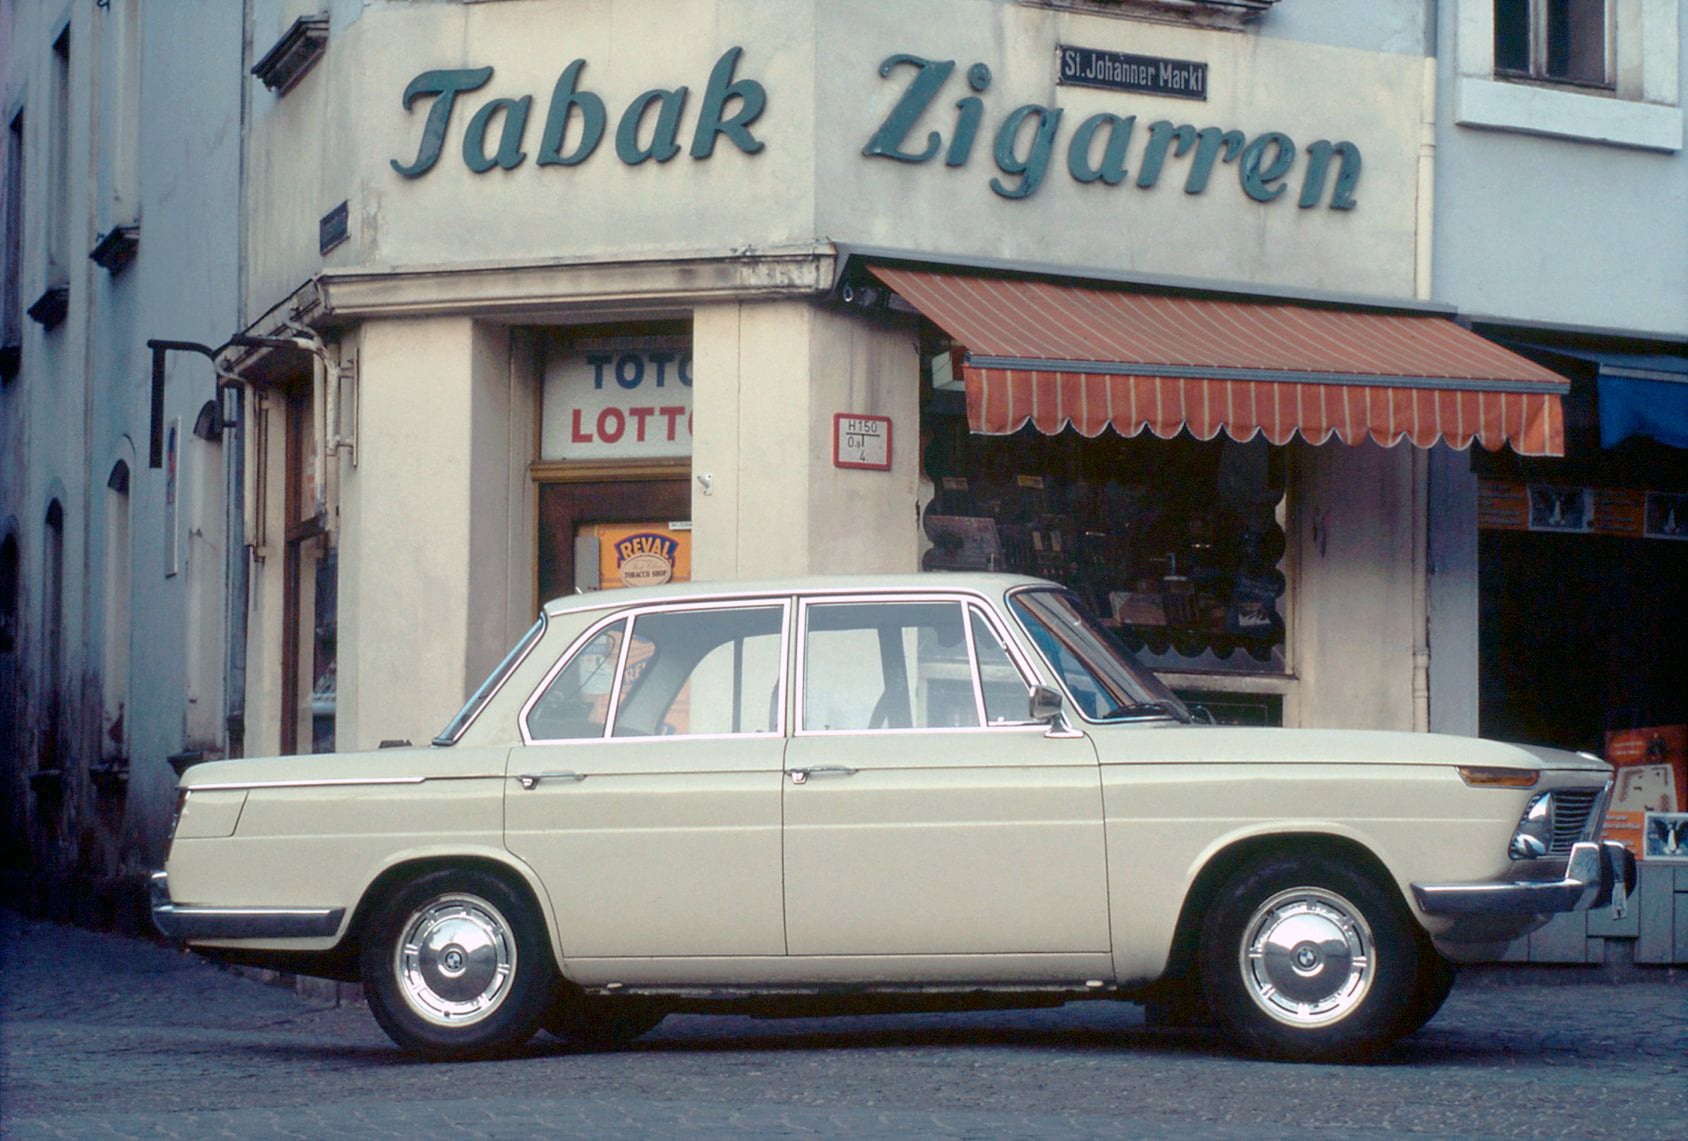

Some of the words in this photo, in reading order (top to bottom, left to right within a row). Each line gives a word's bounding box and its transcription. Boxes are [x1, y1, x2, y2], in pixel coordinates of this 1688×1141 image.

[1065, 50, 1085, 77] St.
[1086, 53, 1155, 86] Johanner
[1159, 62, 1202, 91] Markt
[390, 46, 767, 178] Tabak
[861, 53, 1363, 211] Zigarren
[571, 405, 693, 444] LOTT
[848, 420, 878, 433] H150
[620, 537, 670, 559] REVAL
